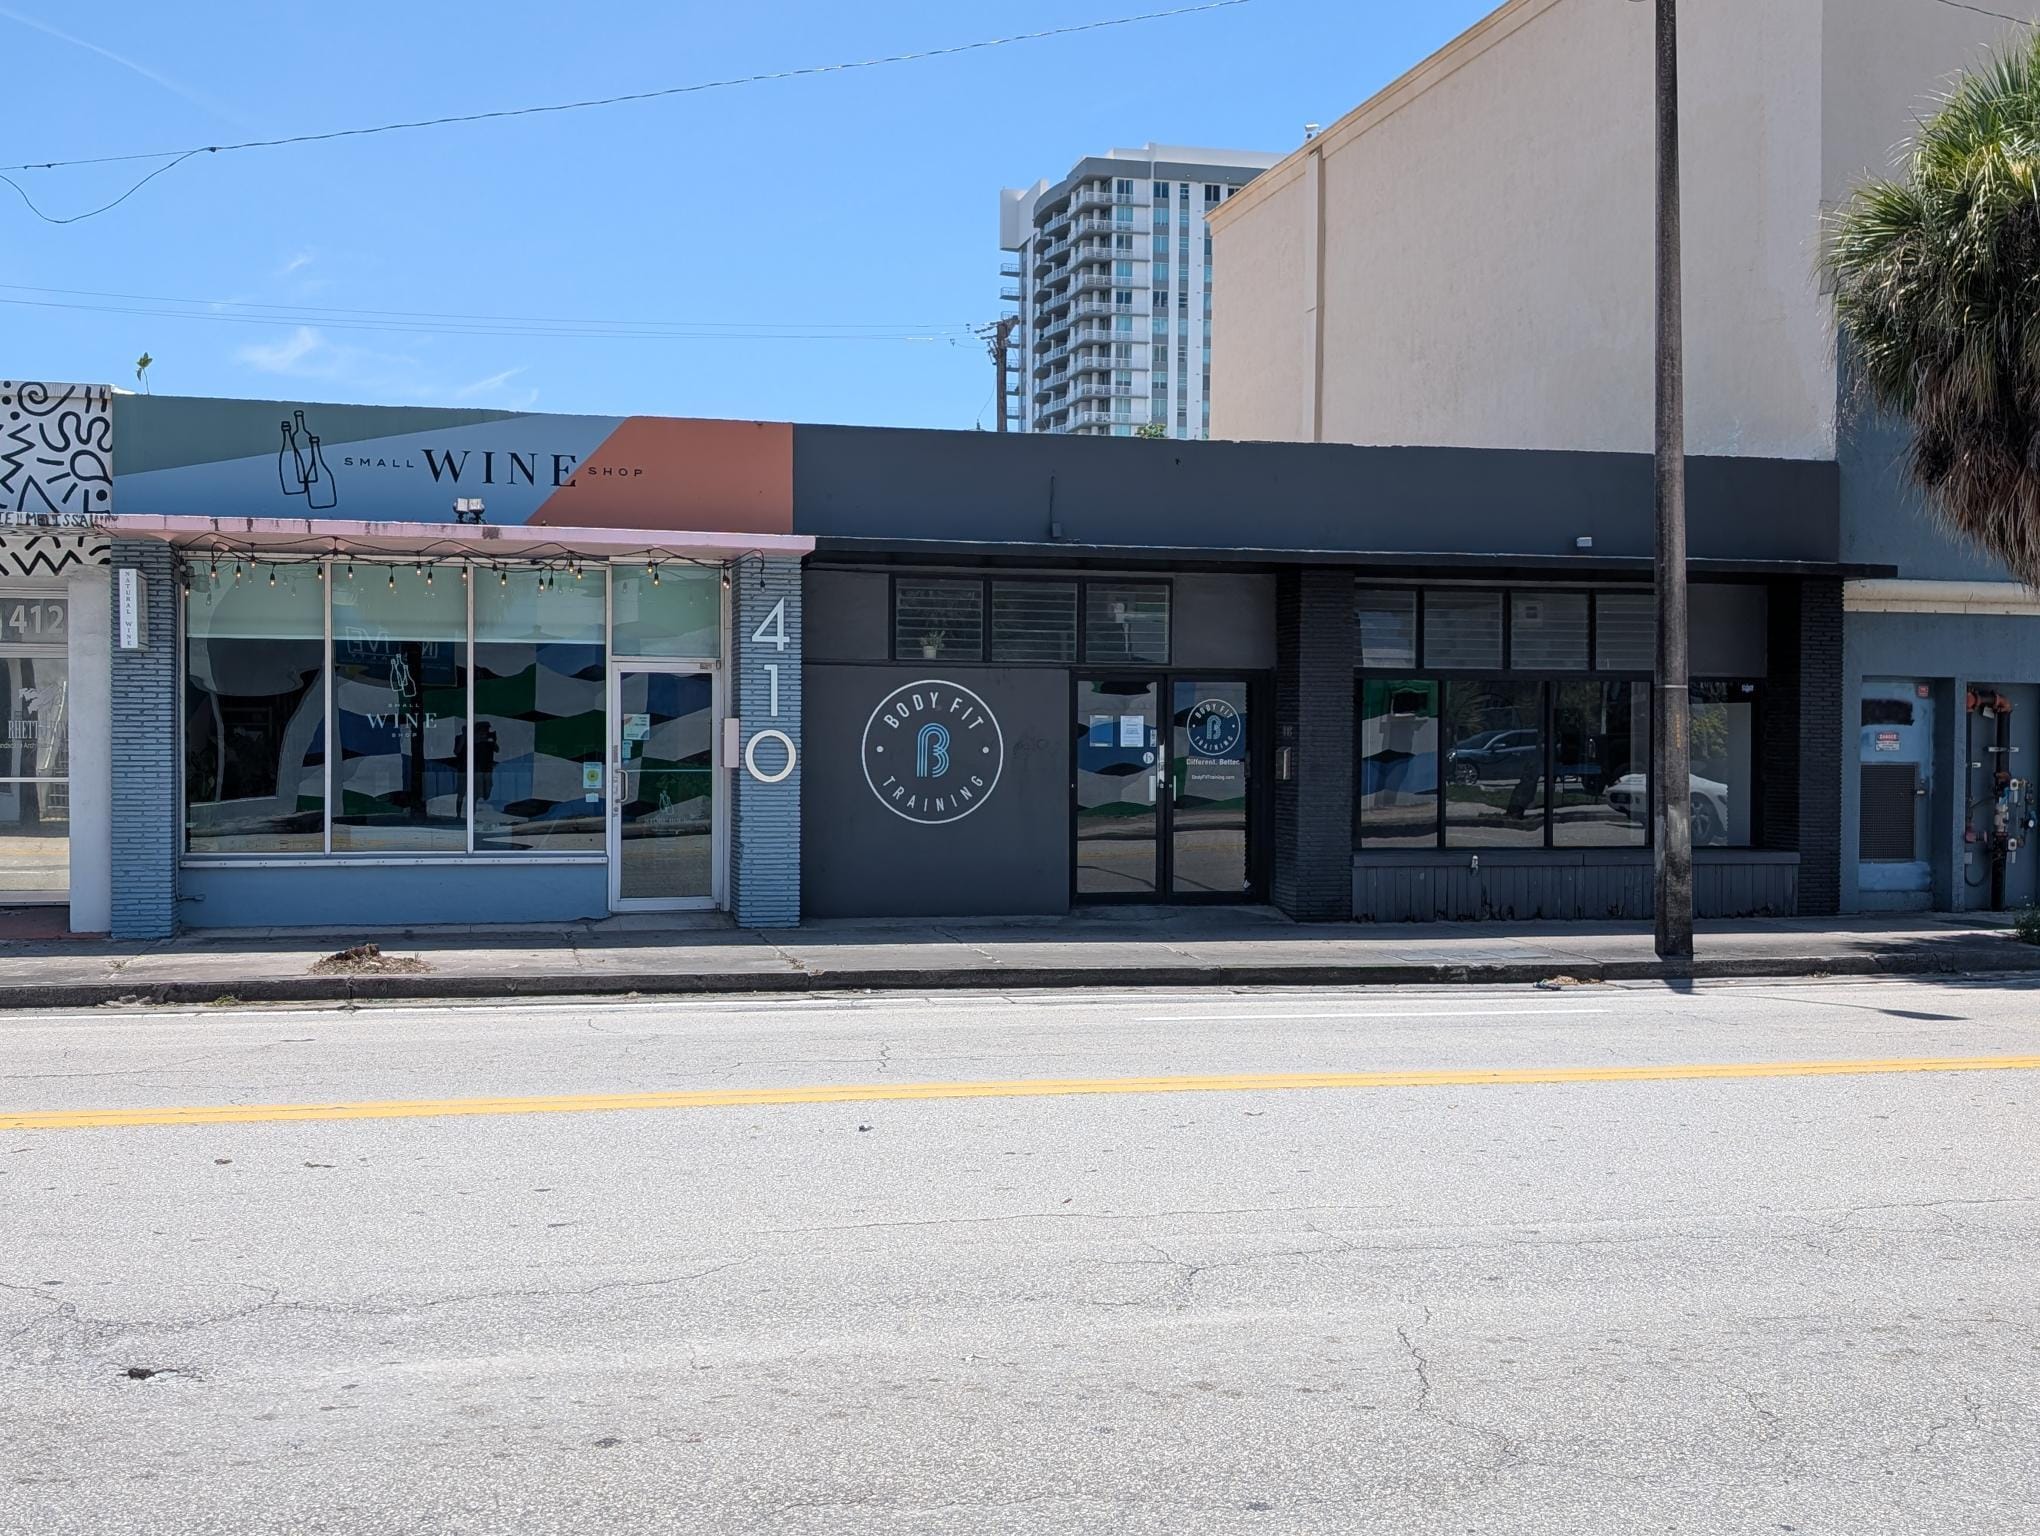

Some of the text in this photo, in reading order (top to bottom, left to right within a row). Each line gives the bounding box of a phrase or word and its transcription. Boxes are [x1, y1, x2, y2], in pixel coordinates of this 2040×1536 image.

[344, 448, 643, 487] SMALL WINE SHOP
[9, 604, 64, 634] 412
[124, 571, 133, 646] NATURAL WINE
[745, 597, 797, 783] 410
[366, 712, 437, 729] WINE
[883, 691, 984, 730] BODY FIT
[1195, 704, 1233, 719] BODY FIT
[8, 720, 38, 739] RHETT
[1195, 736, 1233, 750] TRAINING
[882, 775, 984, 812] TRAINING
